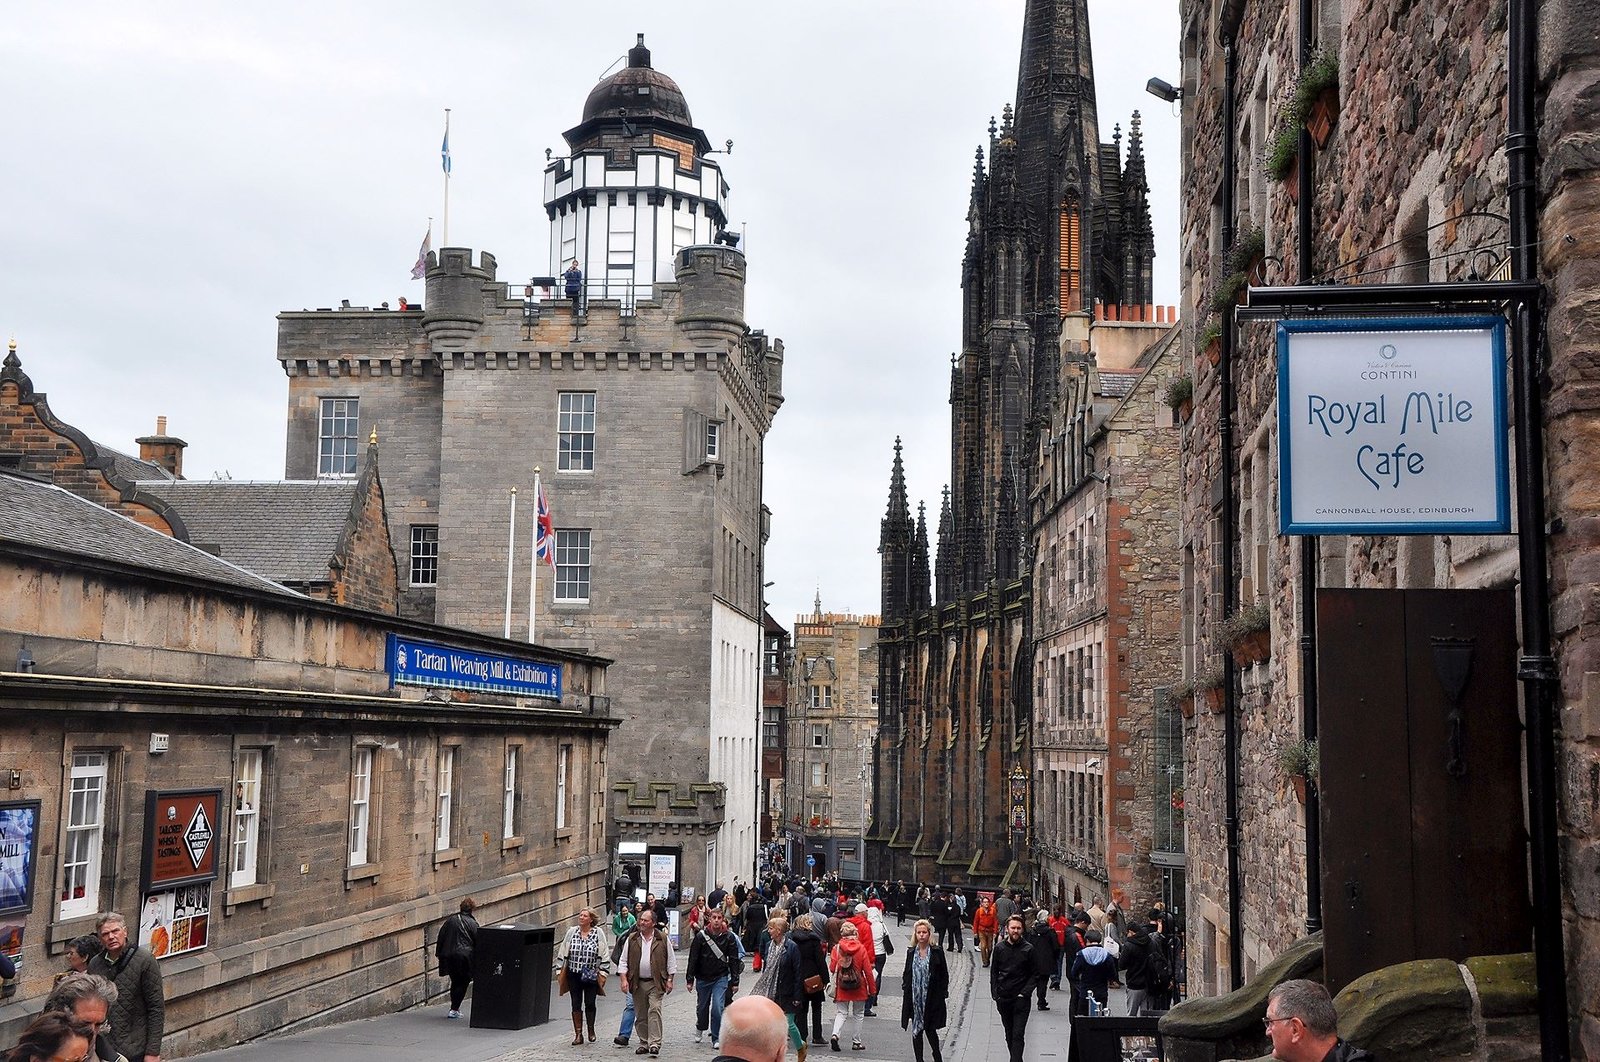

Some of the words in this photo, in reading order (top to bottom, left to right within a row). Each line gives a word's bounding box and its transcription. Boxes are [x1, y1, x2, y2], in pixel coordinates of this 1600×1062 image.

[1360, 370, 1417, 380] CONTINI
[1307, 394, 1386, 437] Royal
[1400, 391, 1473, 435] Mile
[1356, 442, 1425, 490] Cafe
[1380, 507, 1416, 515] HOUSE,
[413, 648, 447, 672] Tartan
[450, 654, 488, 681] Weaving
[490, 660, 504, 679] Mill
[504, 664, 511, 680] &
[512, 664, 548, 685] Exhibition
[159, 836, 179, 846] WHISKY
[188, 831, 210, 841] CASTLEHILL
[191, 840, 207, 848] WHISKY
[158, 847, 181, 858] TASTINGS
